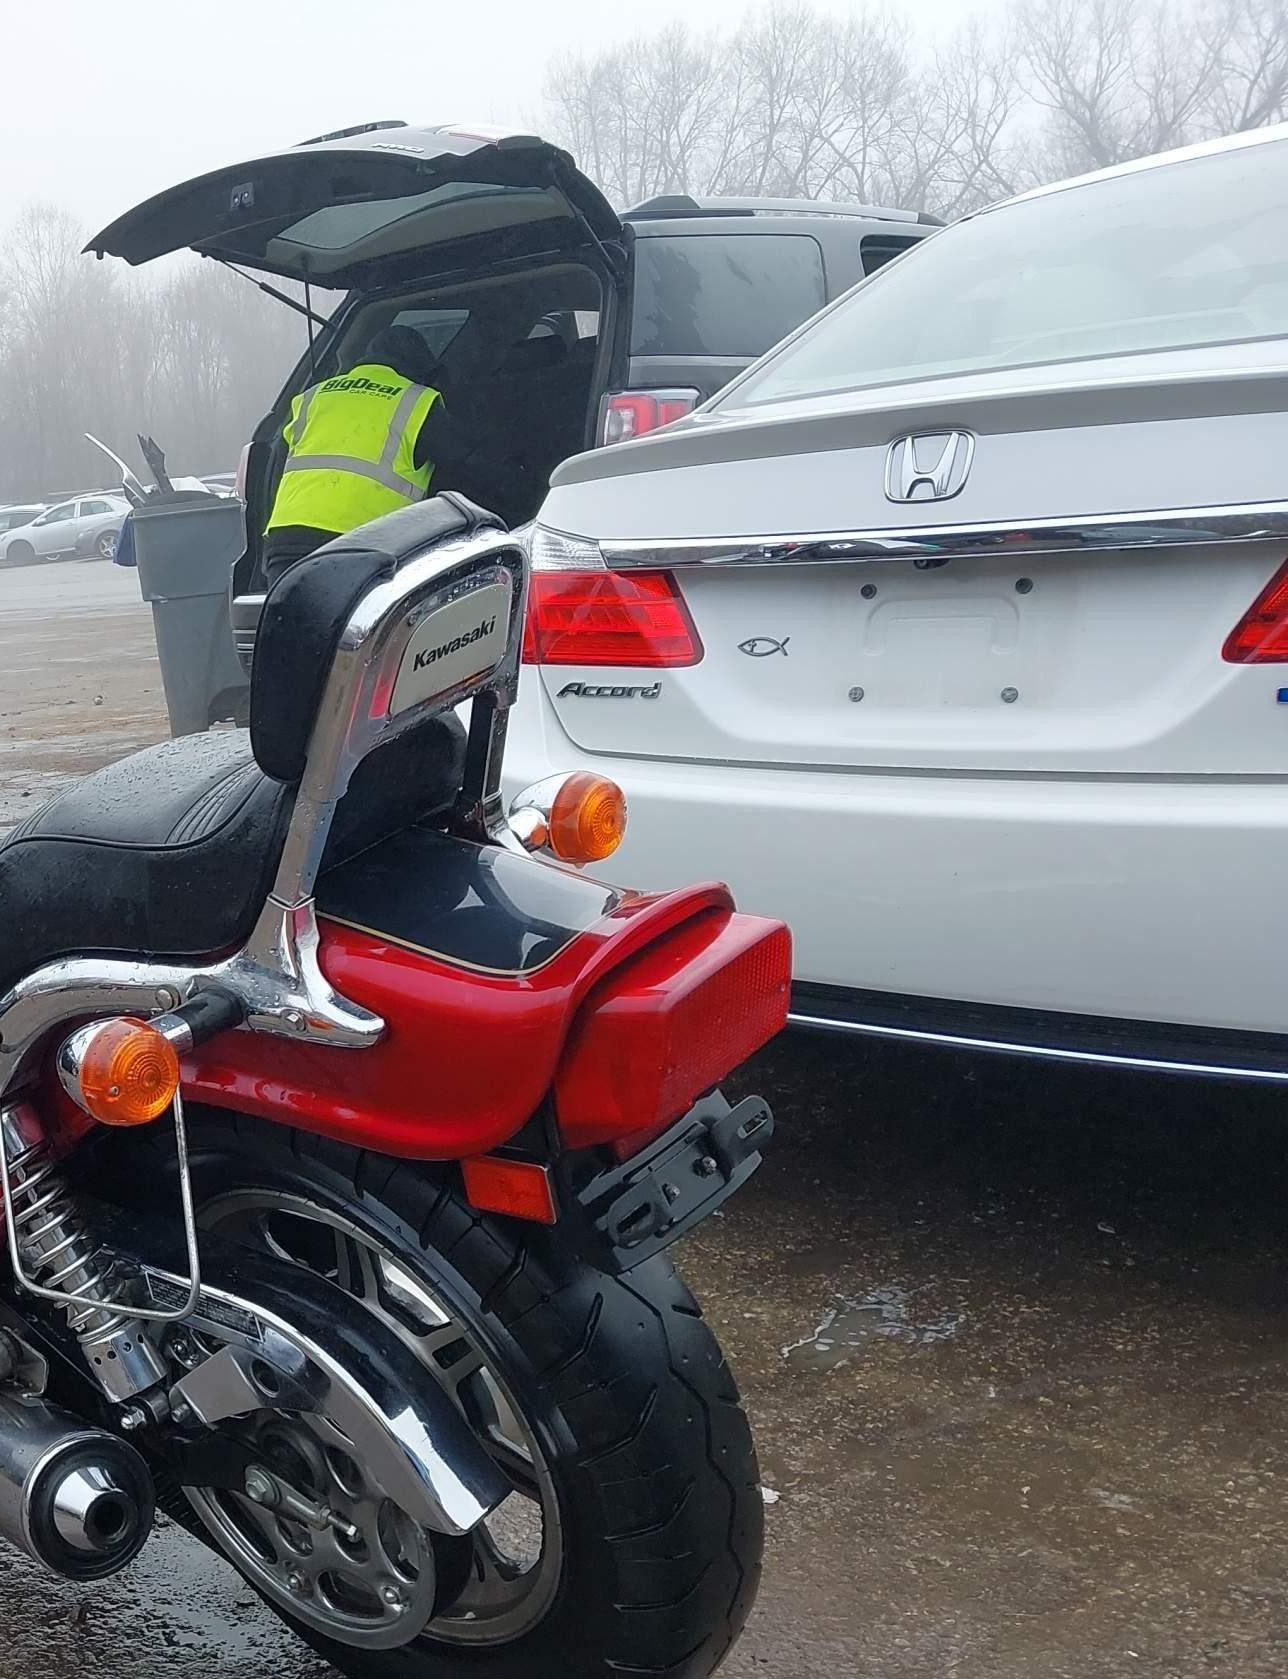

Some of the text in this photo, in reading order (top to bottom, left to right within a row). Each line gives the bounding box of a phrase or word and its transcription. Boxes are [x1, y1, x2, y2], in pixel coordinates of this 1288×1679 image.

[319, 376, 403, 396] BigDeal
[413, 615, 497, 672] Kawasaki
[557, 682, 662, 699] Accord
